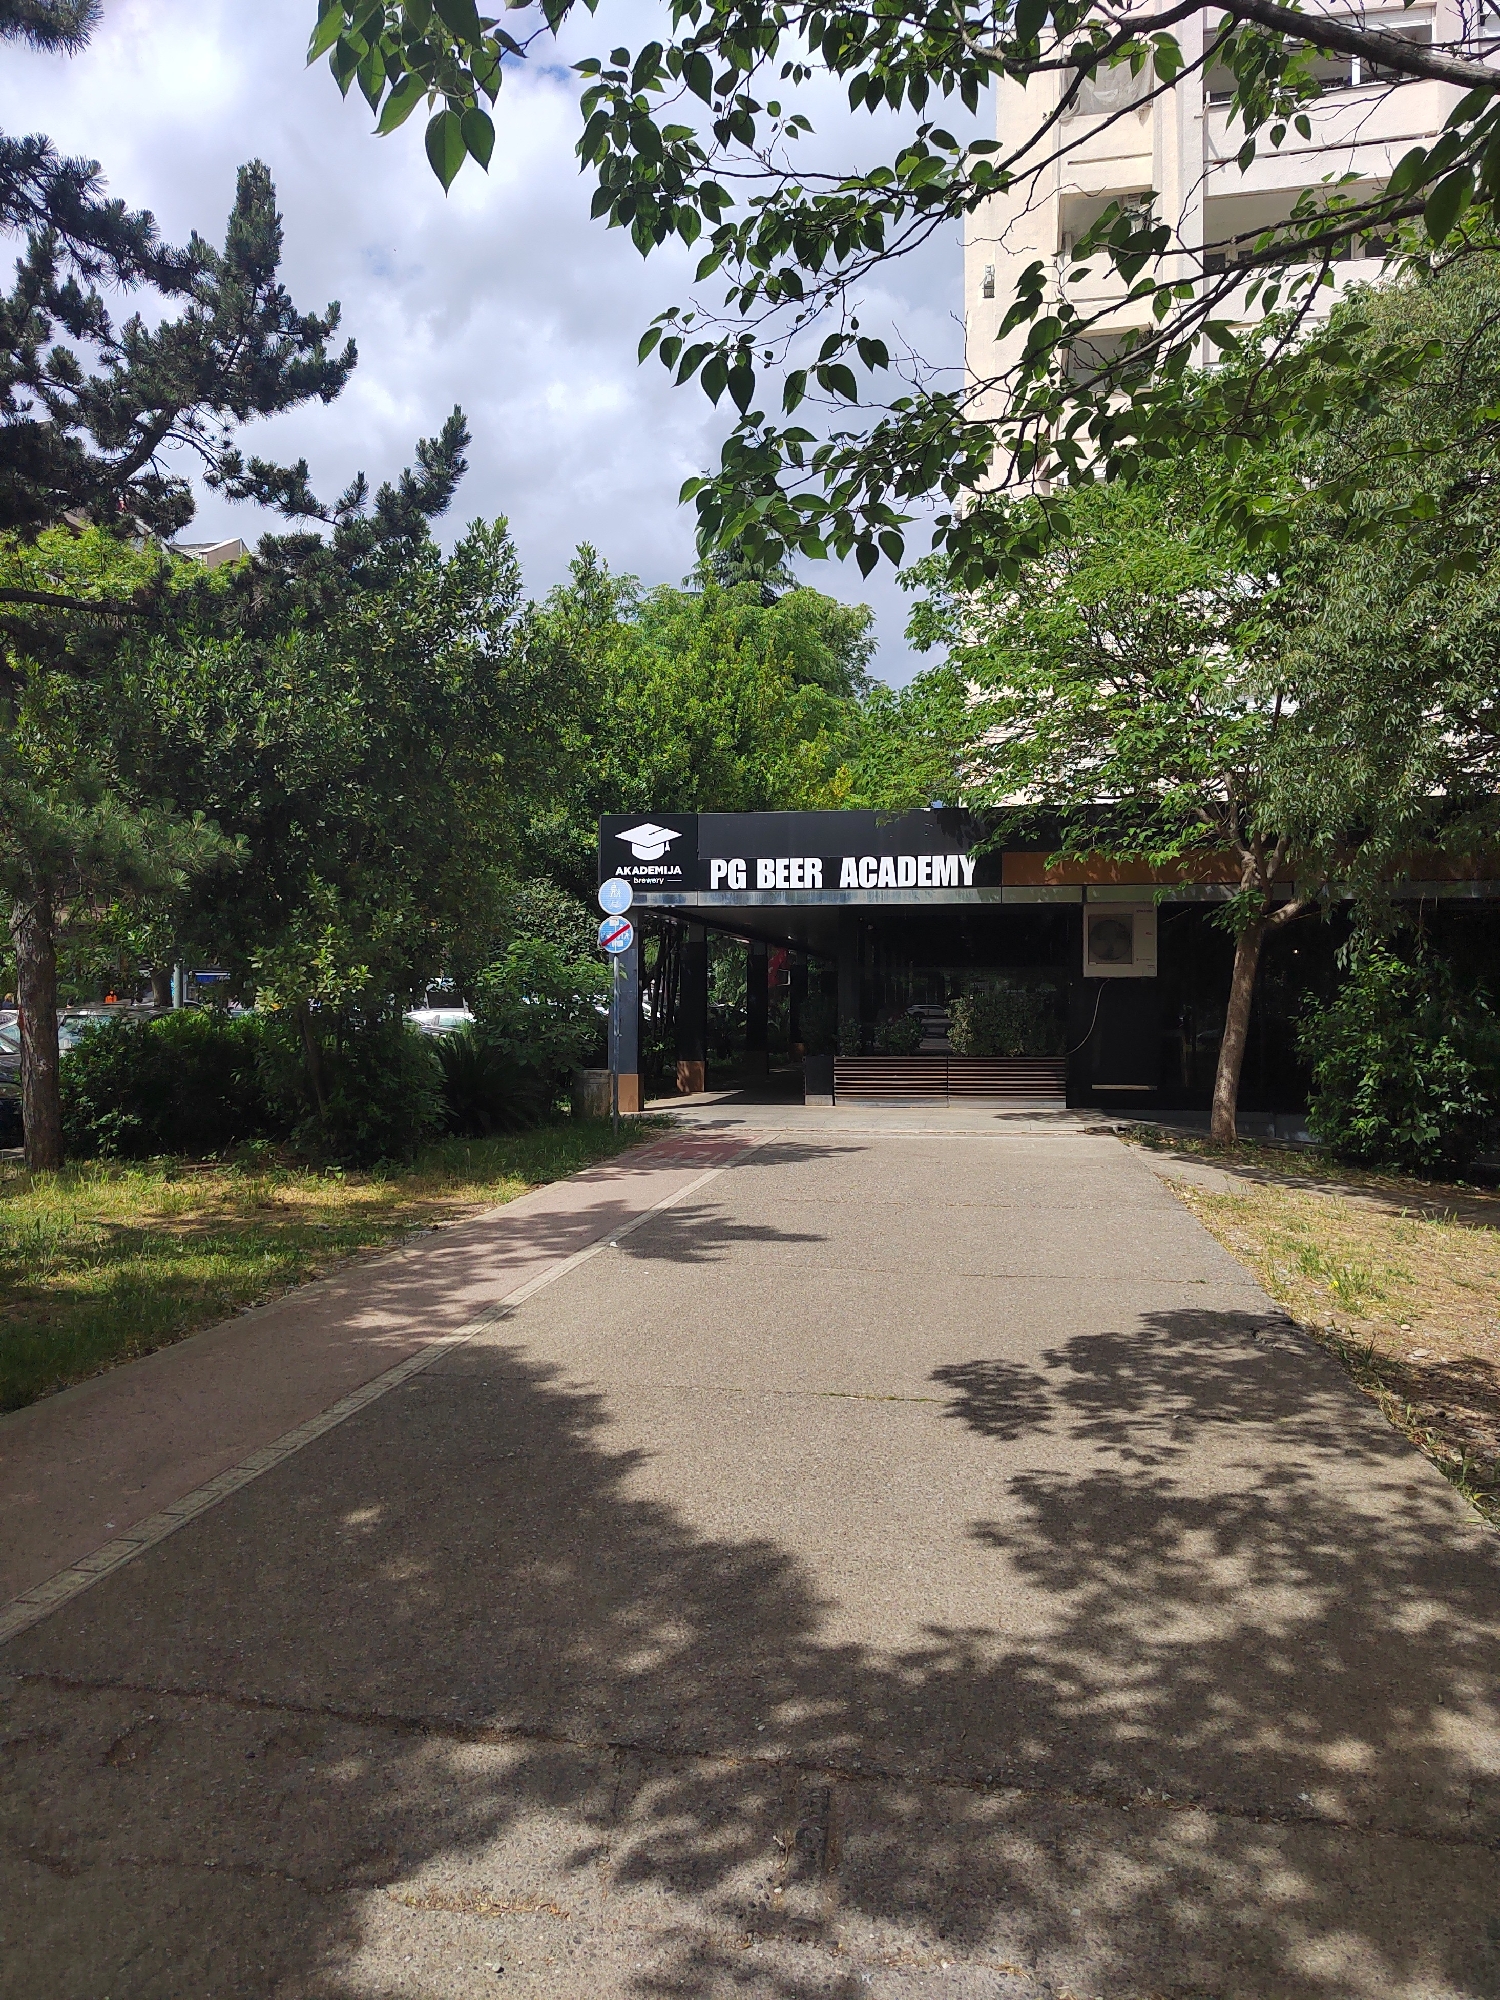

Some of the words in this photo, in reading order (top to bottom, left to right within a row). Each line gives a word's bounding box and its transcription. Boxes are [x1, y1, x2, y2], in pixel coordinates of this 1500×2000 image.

[615, 865, 682, 876] AKADEMIJA
[710, 858, 747, 889] PG
[756, 858, 823, 889] BEER
[839, 854, 977, 888] ACADEMY
[633, 877, 665, 885] brewery
